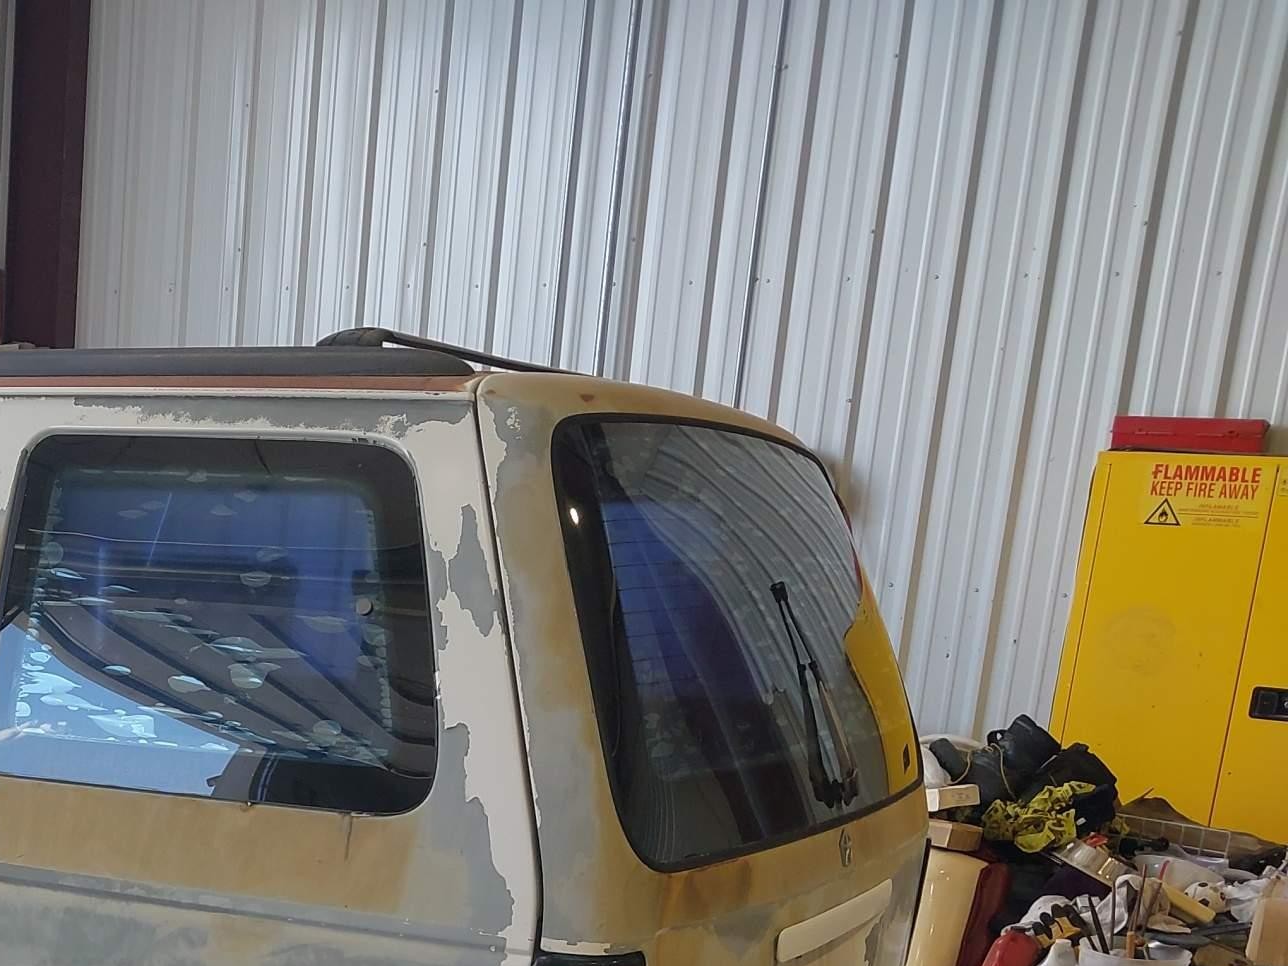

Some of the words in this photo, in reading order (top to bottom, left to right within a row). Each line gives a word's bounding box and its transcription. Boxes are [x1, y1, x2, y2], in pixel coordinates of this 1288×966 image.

[1152, 464, 1261, 484] FLAMMABLE
[1150, 481, 1183, 497] KEEP
[1186, 482, 1215, 498] FIRE
[1219, 483, 1259, 500] AWAY
